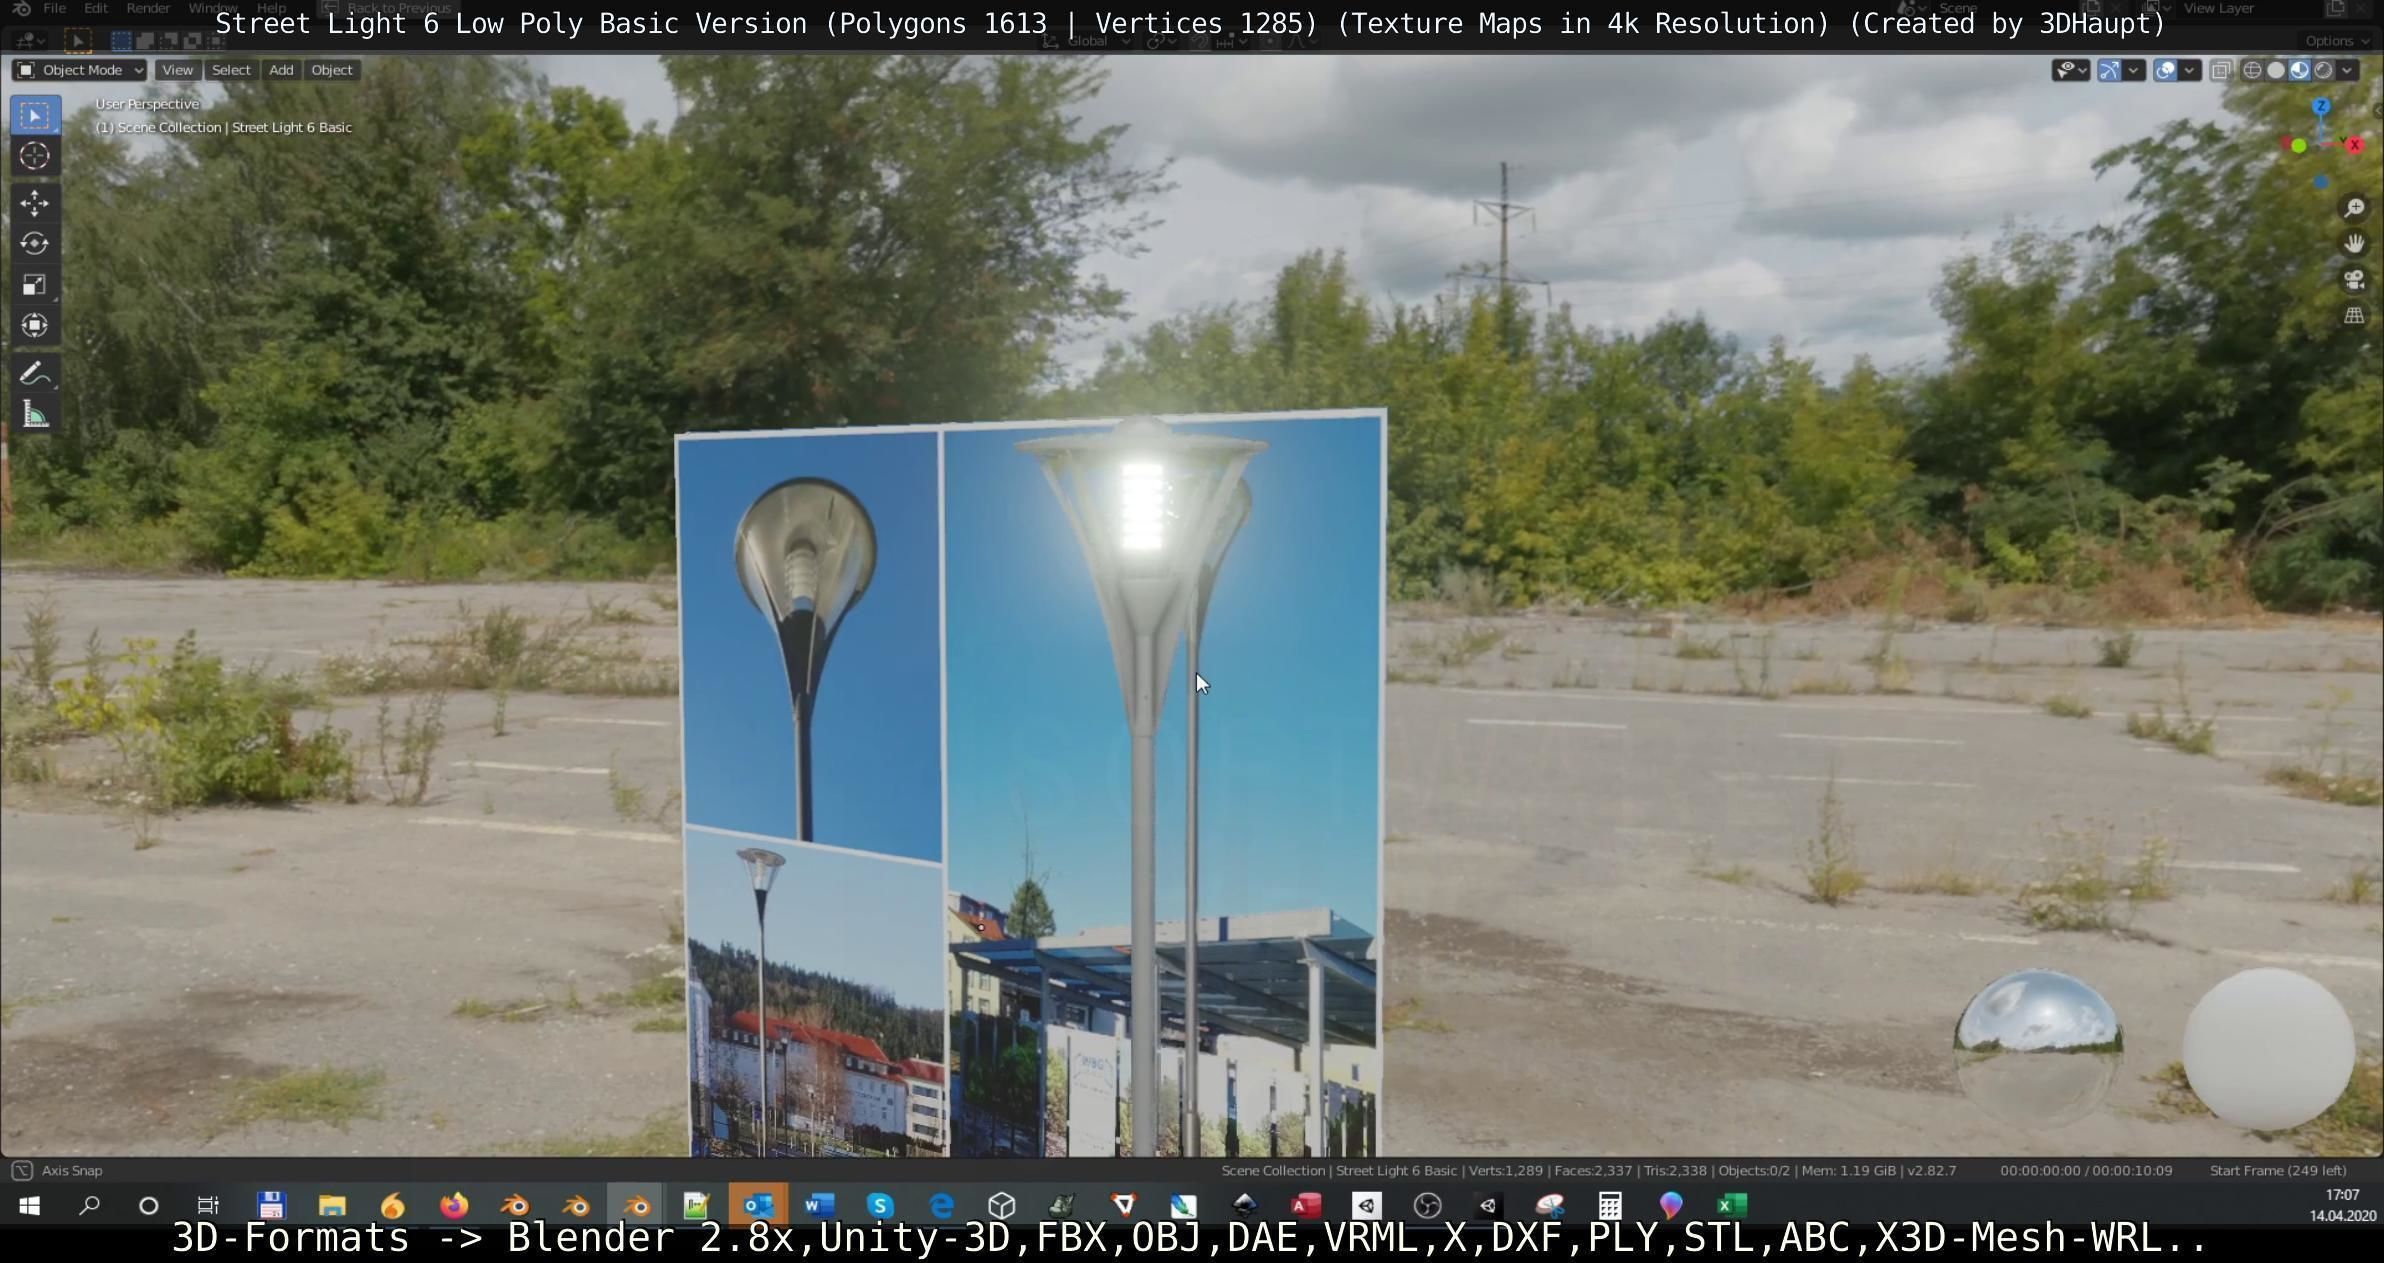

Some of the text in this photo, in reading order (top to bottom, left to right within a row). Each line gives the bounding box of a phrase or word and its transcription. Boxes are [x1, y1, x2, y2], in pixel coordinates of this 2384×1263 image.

[43, 2, 67, 14] File
[84, 2, 109, 14] Edit
[127, 2, 171, 14] Render
[188, 2, 239, 14] Window
[257, 2, 287, 16] Help
[347, 2, 376, 14] Back
[1939, 2, 1978, 14] Scene
[2183, 2, 2255, 17] View Layer
[1067, 35, 1108, 48] Global
[2306, 35, 2354, 49] Options
[43, 63, 123, 79] Object Mode
[162, 64, 194, 76] View
[212, 64, 252, 76] Select
[268, 64, 294, 76] Add
[311, 64, 353, 79] Object
[95, 99, 200, 112] User Perspective
[95, 122, 114, 135] (1)
[118, 122, 156, 133] Scene
[159, 122, 222, 133] Collection
[232, 122, 269, 133] Street
[272, 122, 303, 136] Light
[307, 122, 315, 133] 6
[319, 122, 353, 133] Basic
[42, 1165, 103, 1180] Axis Snap
[1221, 1165, 1260, 1178] Scene
[1262, 1165, 1326, 1178] Collection
[1336, 1165, 1374, 1178] Street
[1377, 1165, 1409, 1179] Light
[1412, 1165, 1421, 1178] 6
[1424, 1165, 1457, 1178] Basic
[1468, 1165, 1543, 1178] Verts:1,289
[1555, 1165, 1633, 1178] Faces:2,337
[1643, 1165, 1707, 1178] Tris:2,338
[1718, 1165, 1790, 1179] Objects:0/2
[1802, 1165, 1837, 1178] Mem:
[1841, 1165, 1870, 1178] 1.19
[1873, 1165, 1897, 1178] GiB
[1907, 1165, 1957, 1178] v2.82.7
[2000, 1165, 2081, 1178] 00:00:00:00
[2092, 1165, 2173, 1178] 00:00:10:09
[2210, 1165, 2347, 1178] Start Frame (249 left)
[2326, 1188, 2360, 1201] 17:07
[2310, 1209, 2378, 1222] 14.04.2020
